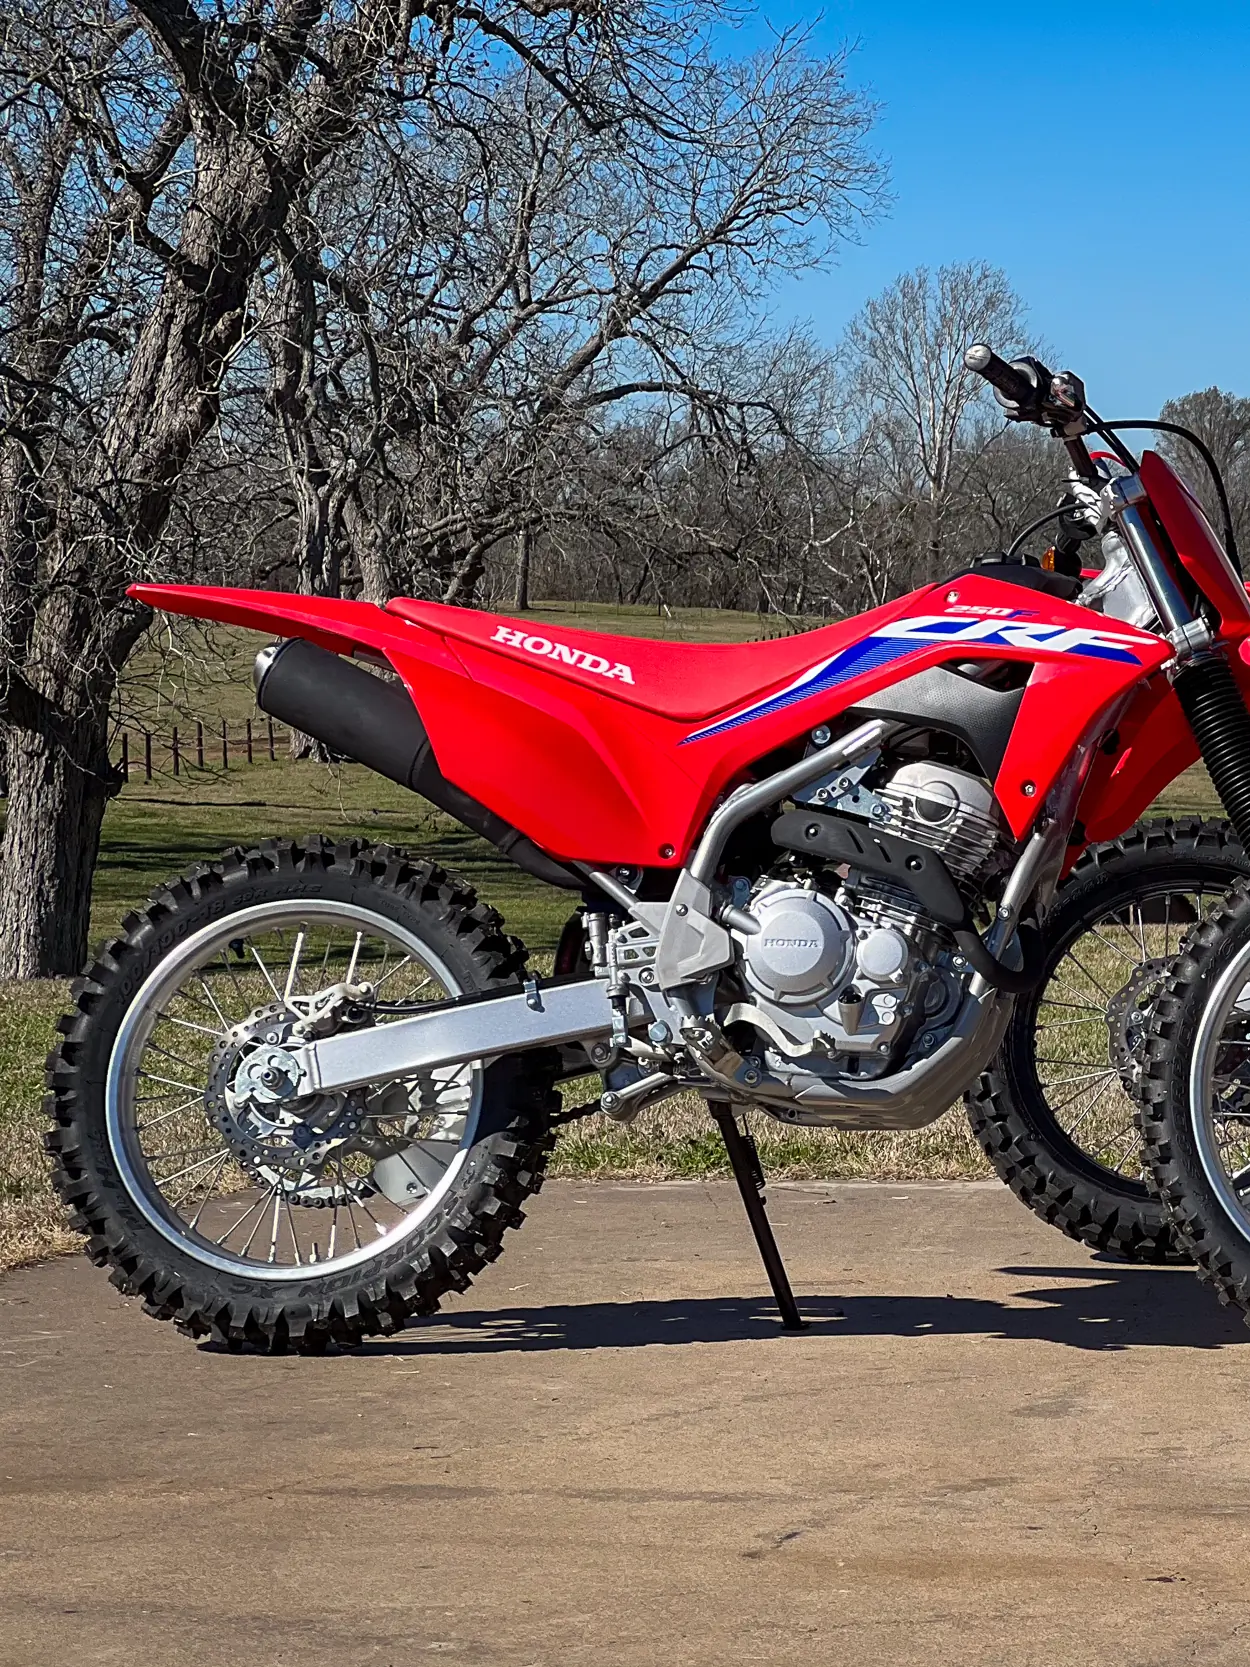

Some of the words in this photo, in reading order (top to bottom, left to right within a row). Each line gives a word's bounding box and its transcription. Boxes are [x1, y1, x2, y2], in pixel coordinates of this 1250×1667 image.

[944, 604, 1040, 618] 250F
[869, 615, 1159, 652] CRF
[490, 625, 636, 685] HONDA
[763, 938, 819, 948] HONDA
